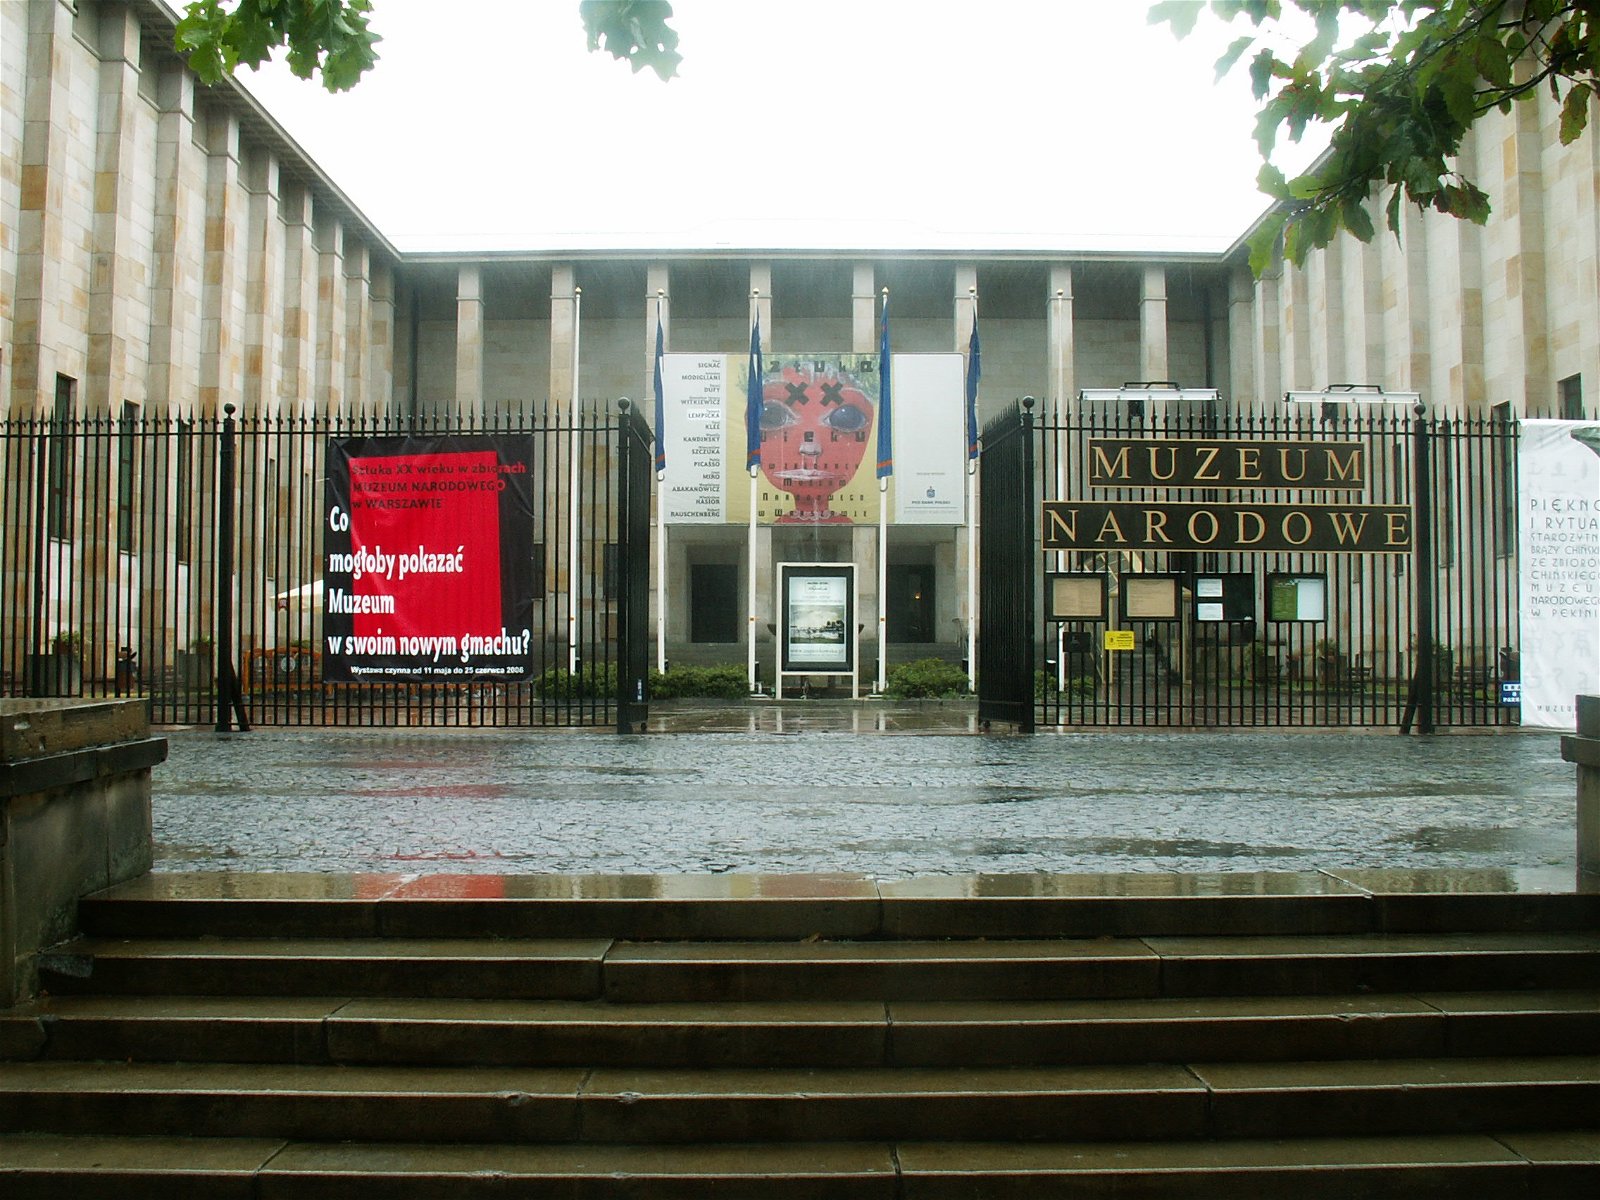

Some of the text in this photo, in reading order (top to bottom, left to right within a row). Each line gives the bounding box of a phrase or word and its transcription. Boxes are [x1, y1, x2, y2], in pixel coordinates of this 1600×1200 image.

[771, 360, 873, 373] ztuka
[352, 461, 526, 475] Sztuka XX wieku w zbiorach
[1091, 446, 1363, 482] MUZEUM
[353, 480, 506, 492] MUZEUM NARODOWEGO
[352, 499, 442, 510] w WARSZAWIE
[330, 505, 348, 532] Co
[1530, 517, 1534, 529] I
[1046, 509, 1410, 545] NARODOWE
[1531, 545, 1560, 557] BRĄZY
[329, 545, 464, 580] mogłoby pokazać
[1531, 558, 1546, 567] ZE
[328, 588, 395, 614] Muzeum
[1531, 596, 1600, 605] NARODOWEG
[1531, 609, 1541, 617] W
[328, 627, 530, 662] w swoim nowym gmachu?
[350, 666, 383, 675] Wystawa
[385, 667, 411, 675] czynna
[412, 666, 423, 674] od
[424, 666, 432, 674] 11
[433, 667, 451, 675] maja
[453, 666, 463, 674] do
[464, 666, 474, 674] 25
